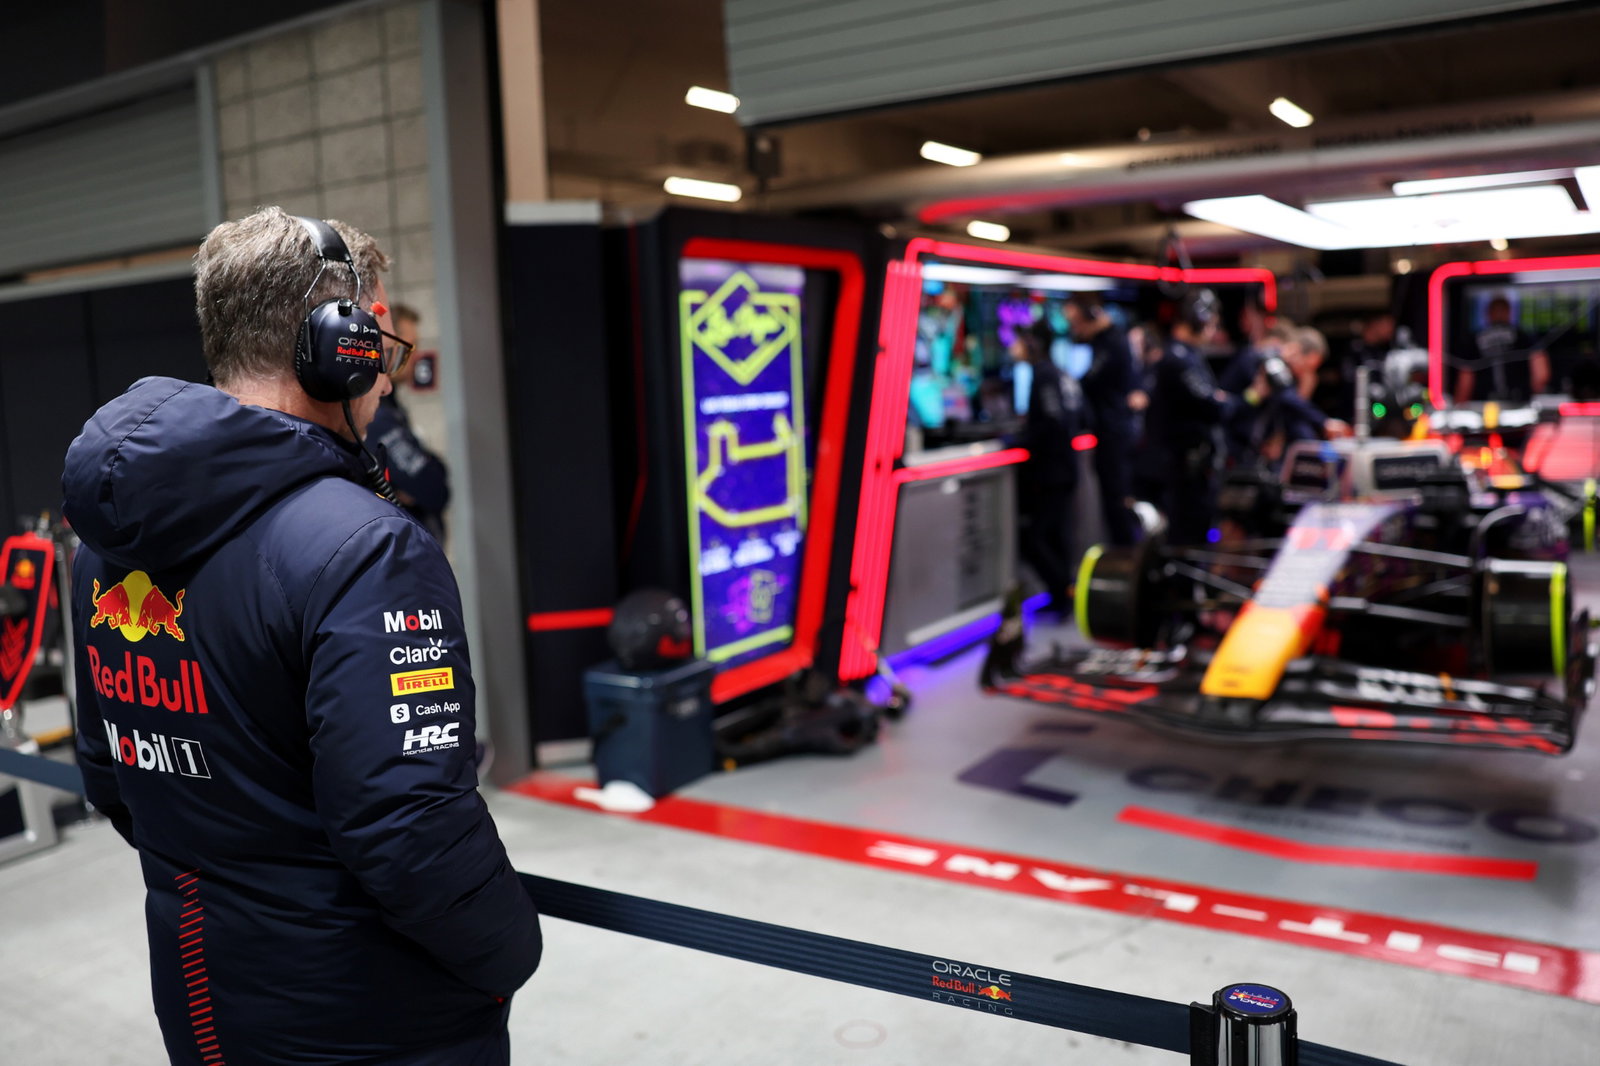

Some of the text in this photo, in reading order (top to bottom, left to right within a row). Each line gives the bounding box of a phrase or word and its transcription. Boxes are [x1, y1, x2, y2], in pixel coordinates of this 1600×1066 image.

[338, 337, 382, 351] ORACLE
[383, 609, 443, 633] Mobil
[389, 641, 445, 665] Claro
[87, 645, 209, 714] Red Bull
[397, 672, 449, 691] PIRELLI
[415, 703, 442, 716] Cash
[443, 701, 461, 714] App
[103, 718, 199, 775] Mobil 1
[403, 722, 460, 751] HRC
[433, 742, 460, 751] RACING
[932, 960, 1012, 987] ORACLE
[932, 975, 975, 994] Red Bull
[932, 992, 1013, 1016] RACING
[1229, 995, 1274, 1009] ORACLE
